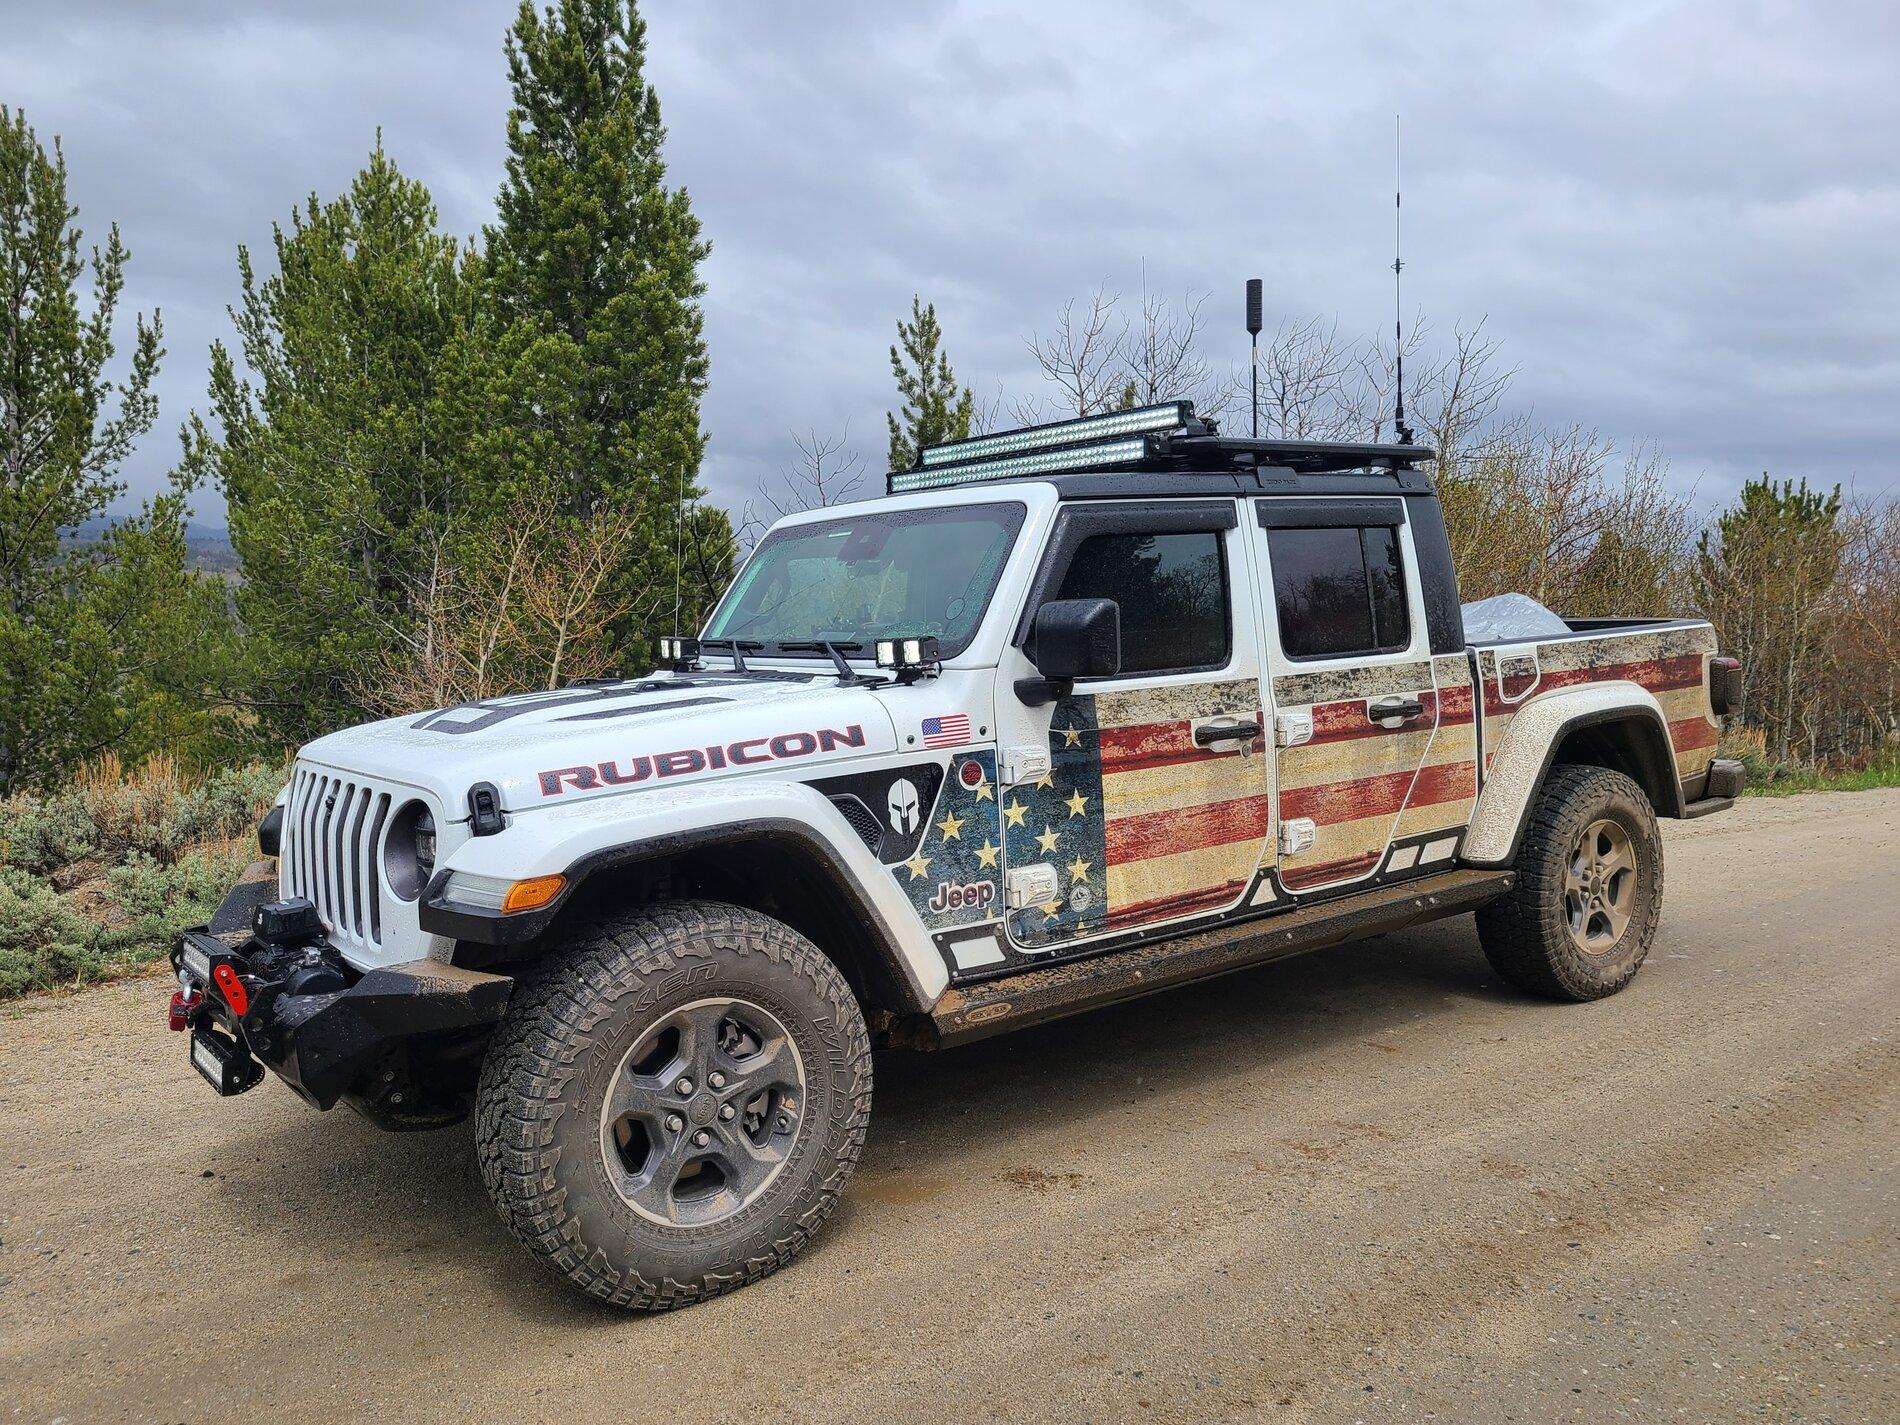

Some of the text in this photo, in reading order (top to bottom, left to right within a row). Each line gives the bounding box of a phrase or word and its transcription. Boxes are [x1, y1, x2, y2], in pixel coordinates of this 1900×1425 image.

[537, 724, 866, 797] RUBICON
[929, 880, 995, 913] Jeep
[779, 1016, 847, 1232] WILDPEAK
